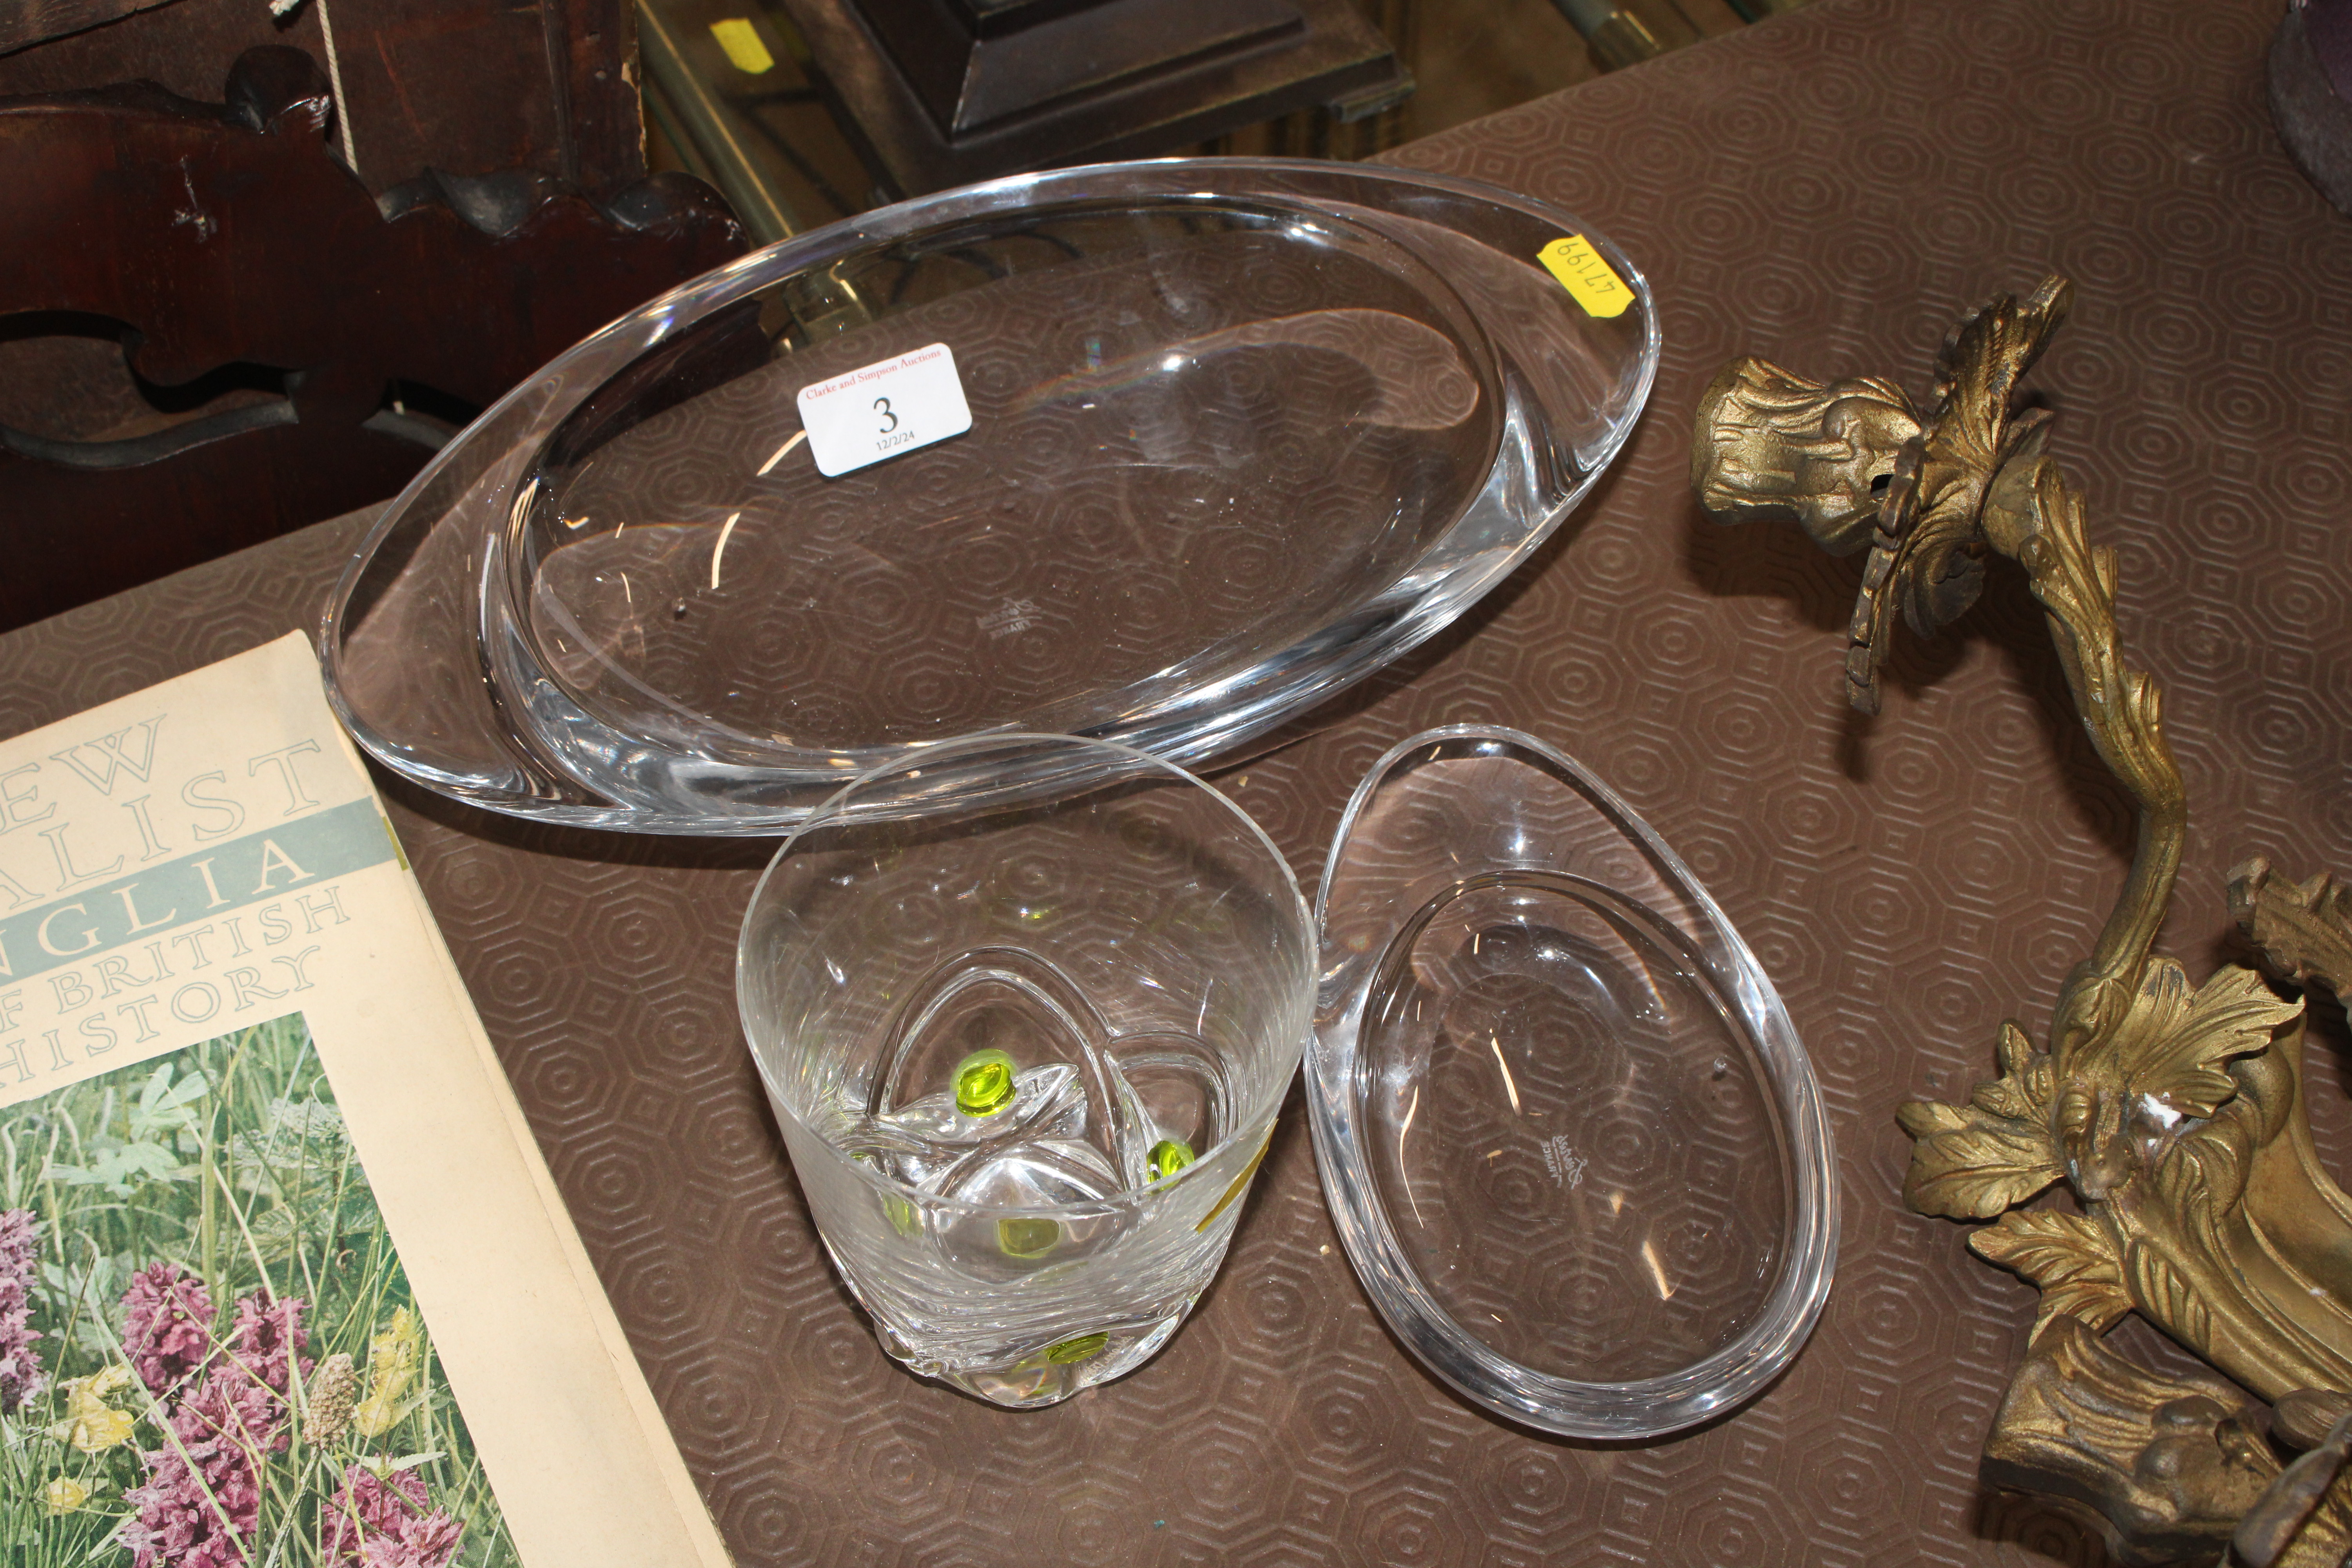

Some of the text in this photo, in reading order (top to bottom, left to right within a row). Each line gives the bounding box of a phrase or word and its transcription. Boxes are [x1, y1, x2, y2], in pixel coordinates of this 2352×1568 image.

[1557, 243, 1615, 293] 47199
[806, 350, 941, 400] Clarke and Simpson Auctions
[873, 397, 898, 434] 3
[876, 430, 915, 451] 12/2/24
[48, 886, 350, 1014] BRITISH
